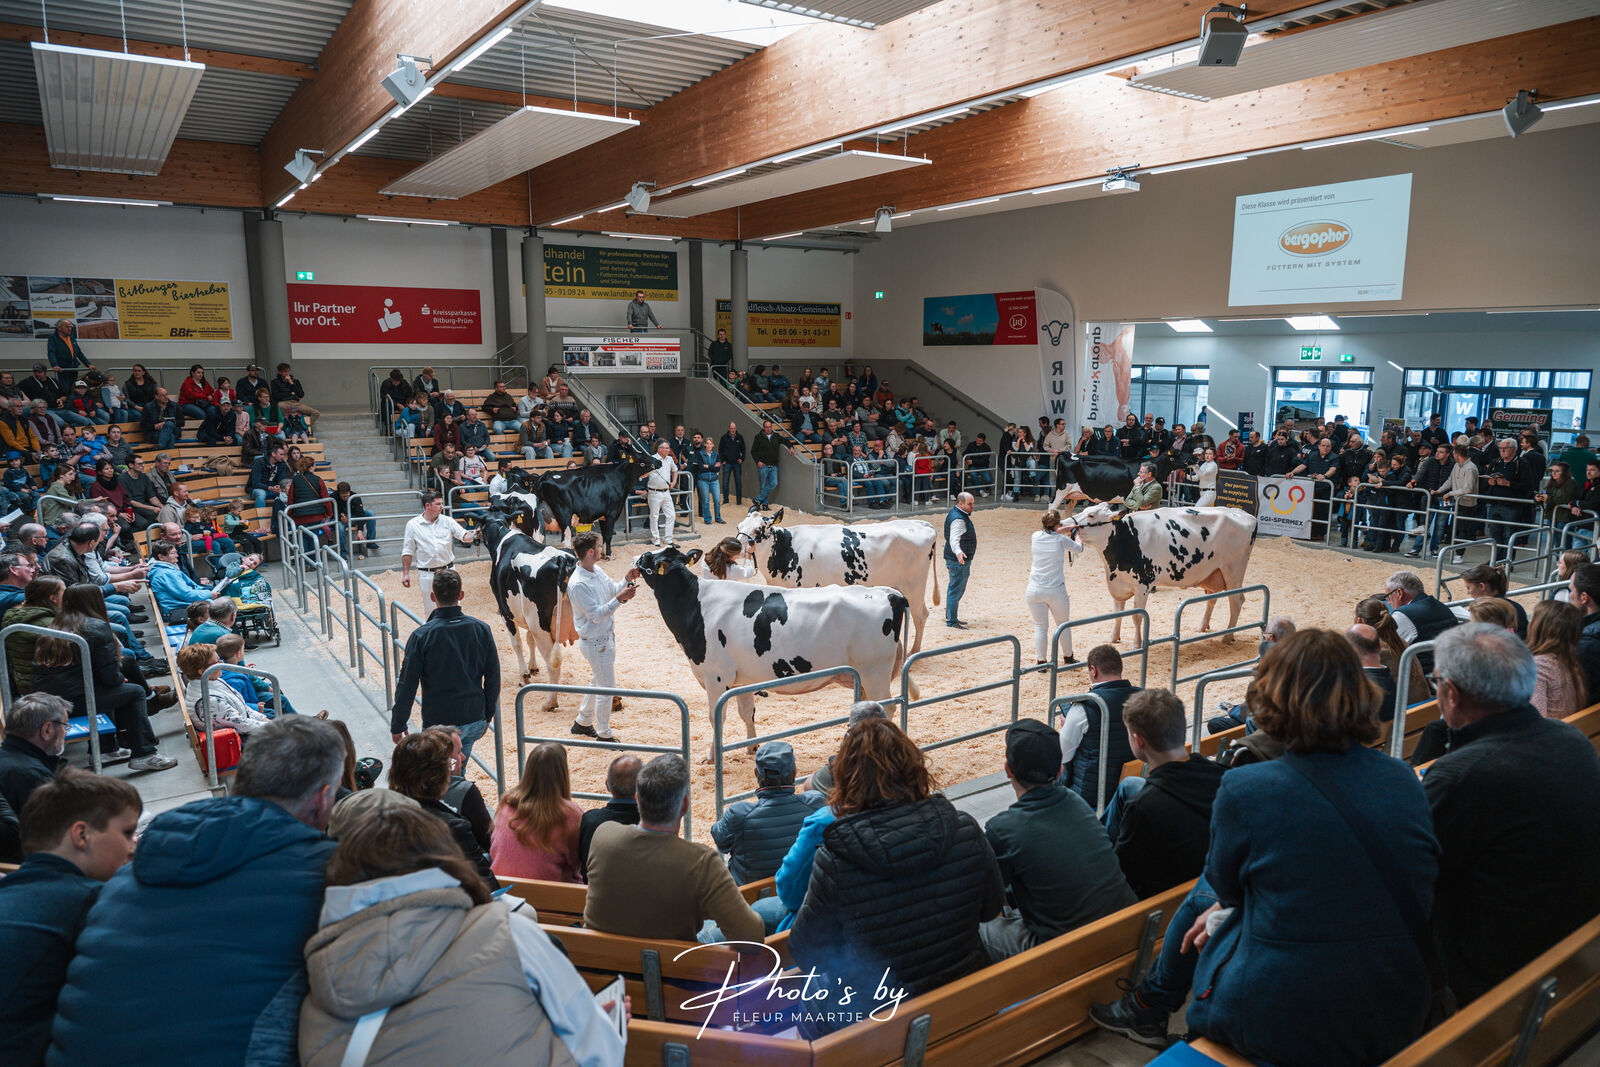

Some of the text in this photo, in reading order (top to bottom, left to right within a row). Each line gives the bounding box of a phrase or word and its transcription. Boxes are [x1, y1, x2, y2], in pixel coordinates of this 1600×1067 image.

[1258, 200, 1276, 208] Klasse
[1277, 198, 1289, 206] wird
[1290, 195, 1323, 205] präsentiert
[544, 247, 585, 260] dhandel
[1267, 263, 1303, 271] FÜTTERN
[1325, 259, 1361, 267] SYSTEM
[543, 261, 585, 283] tein
[118, 282, 179, 298] Bitburger
[172, 283, 228, 301] Biertreber
[294, 301, 356, 313] Ihr Partner
[748, 303, 839, 313] dfleisch-Absatz-Gemeinschaft
[295, 315, 340, 325] vor Ort.
[433, 317, 473, 325] Bitburg-Prüm
[757, 327, 768, 335] Tel.
[1493, 410, 1548, 425] Germing
[1260, 515, 1304, 526] GGI-SPERMEX
